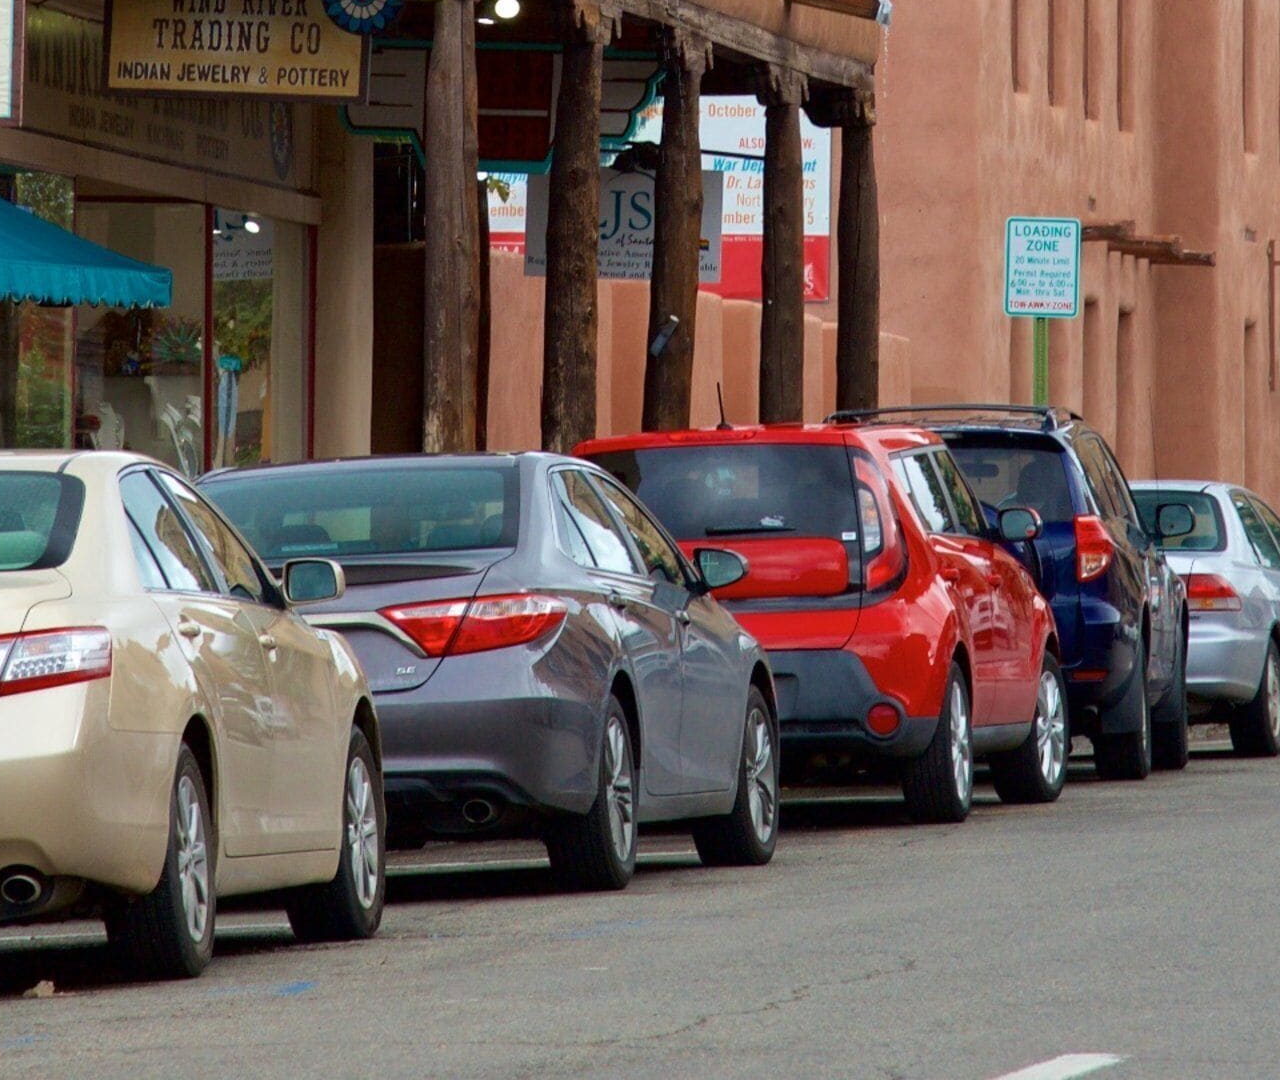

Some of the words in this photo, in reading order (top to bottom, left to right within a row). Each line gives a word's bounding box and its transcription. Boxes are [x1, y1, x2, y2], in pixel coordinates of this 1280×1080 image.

[153, 18, 270, 54] TRADING
[290, 22, 321, 55] CO
[117, 61, 170, 82] INDIAN
[176, 63, 252, 83] JEWELRY
[258, 66, 269, 85] &
[276, 68, 350, 88] POTTERY
[708, 103, 757, 117] October
[739, 137, 765, 149] ALSO
[713, 157, 738, 172] War
[726, 175, 743, 190] Dr.
[1015, 225, 1072, 238] LOADING
[1026, 240, 1060, 252] ZONE
[599, 249, 620, 258] ative
[1014, 269, 1037, 277] Permit
[1040, 270, 1072, 279] Required
